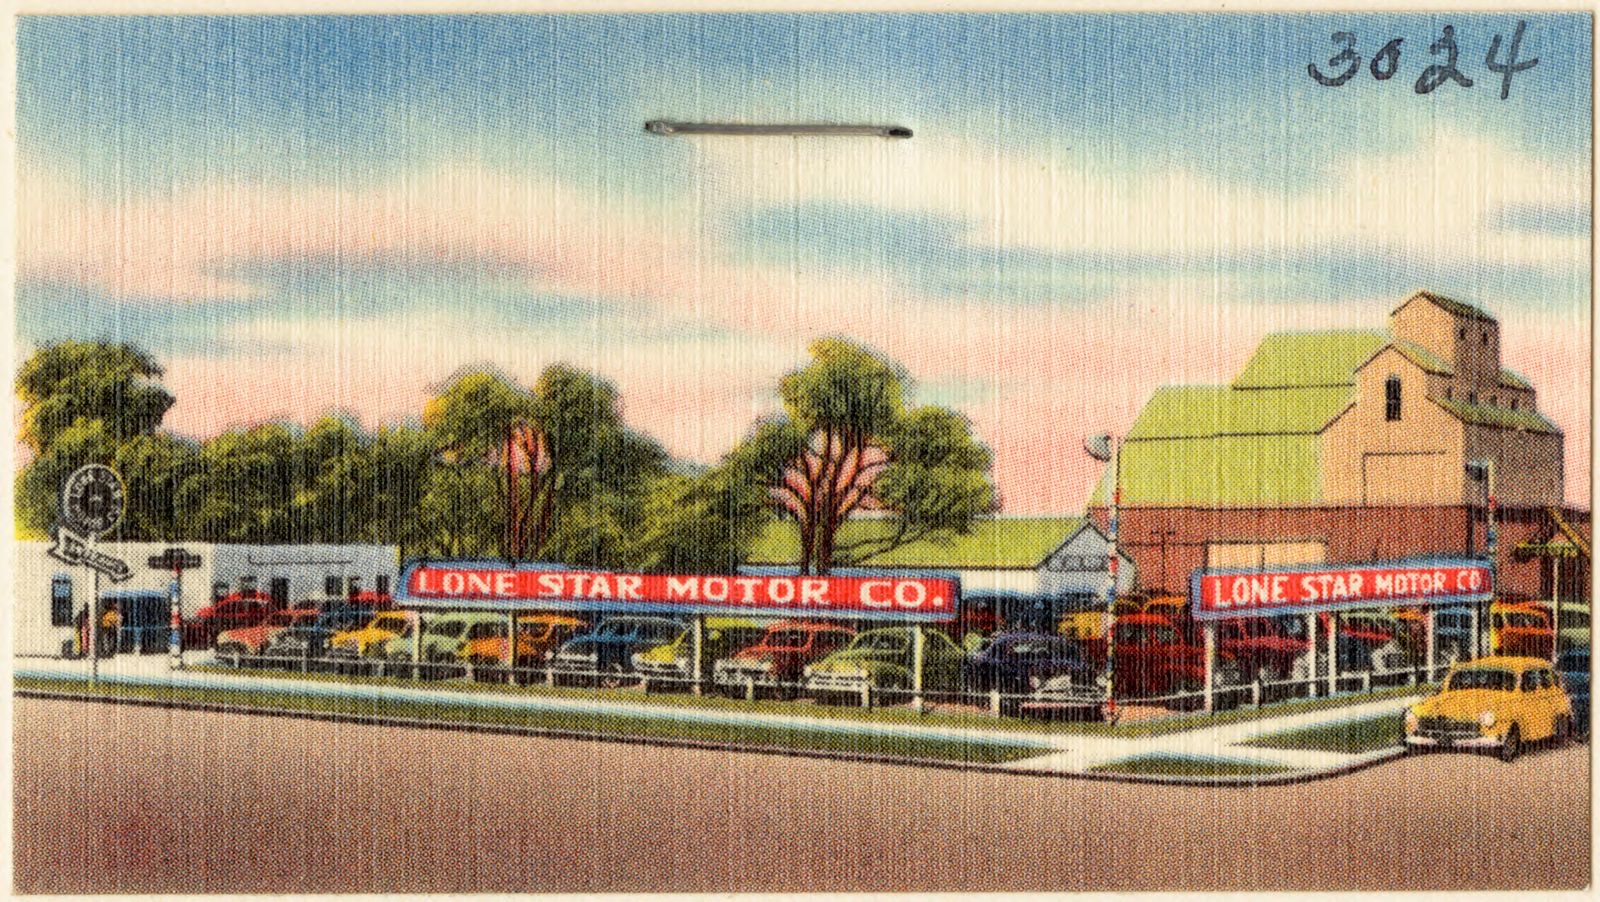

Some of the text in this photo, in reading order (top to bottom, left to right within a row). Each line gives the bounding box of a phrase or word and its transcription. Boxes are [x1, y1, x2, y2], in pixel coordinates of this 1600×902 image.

[1307, 20, 1539, 100] 3024
[417, 568, 945, 607] LONE STAR MOTOR CO.
[1213, 575, 1289, 608] LONE
[1300, 573, 1366, 601] STAR
[1374, 570, 1447, 594] MOTOR
